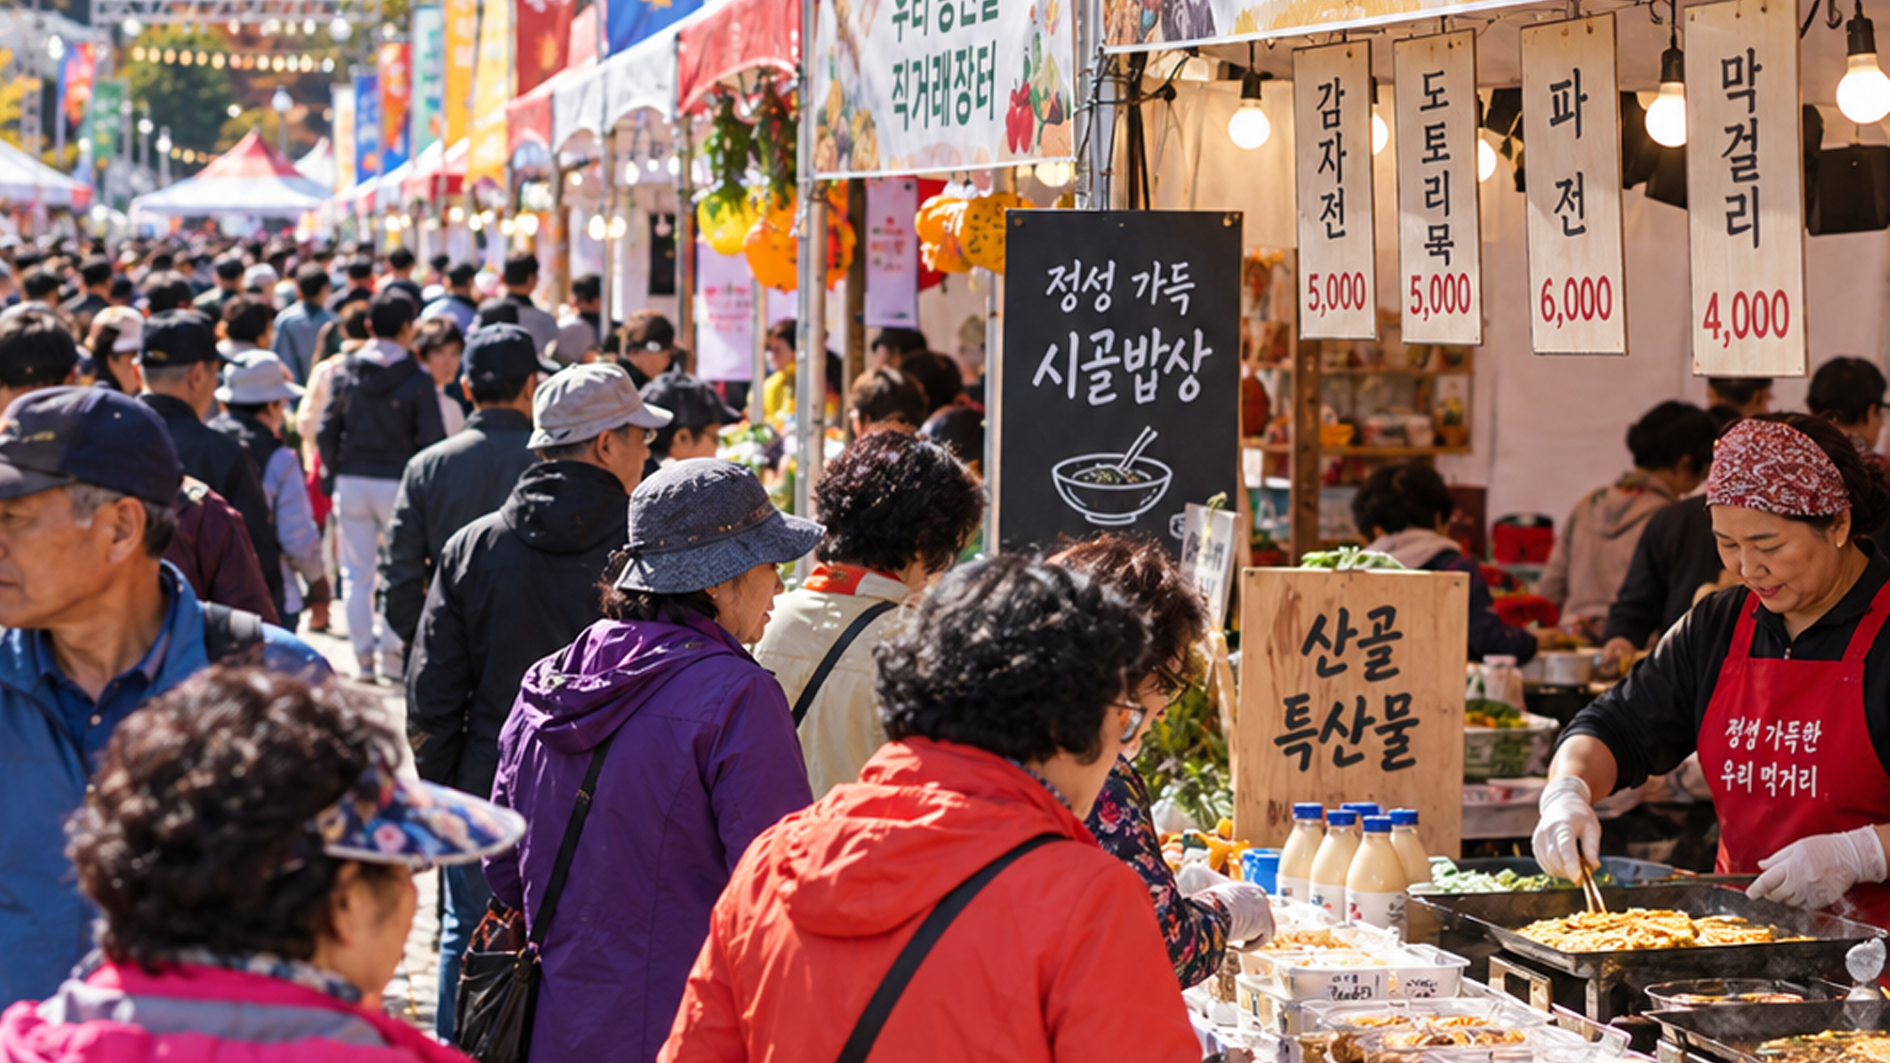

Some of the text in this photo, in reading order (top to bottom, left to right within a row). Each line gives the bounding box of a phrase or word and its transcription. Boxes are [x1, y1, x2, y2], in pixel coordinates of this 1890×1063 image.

[892, 39, 997, 132] 직거래장터
[1316, 76, 1348, 240] 감자전
[1720, 46, 1763, 249] 막걸리
[1045, 259, 1196, 316] 정성 가득
[1308, 271, 1366, 318] 5,000
[1410, 272, 1471, 322] 5,000
[1540, 275, 1613, 329] 6,000
[1702, 288, 1790, 349] 4,000
[1032, 326, 1213, 406] 시골밥상
[1300, 605, 1404, 683] 산골
[1273, 692, 1421, 773] 특산물
[1720, 759, 1818, 799] 우리 먹거리
